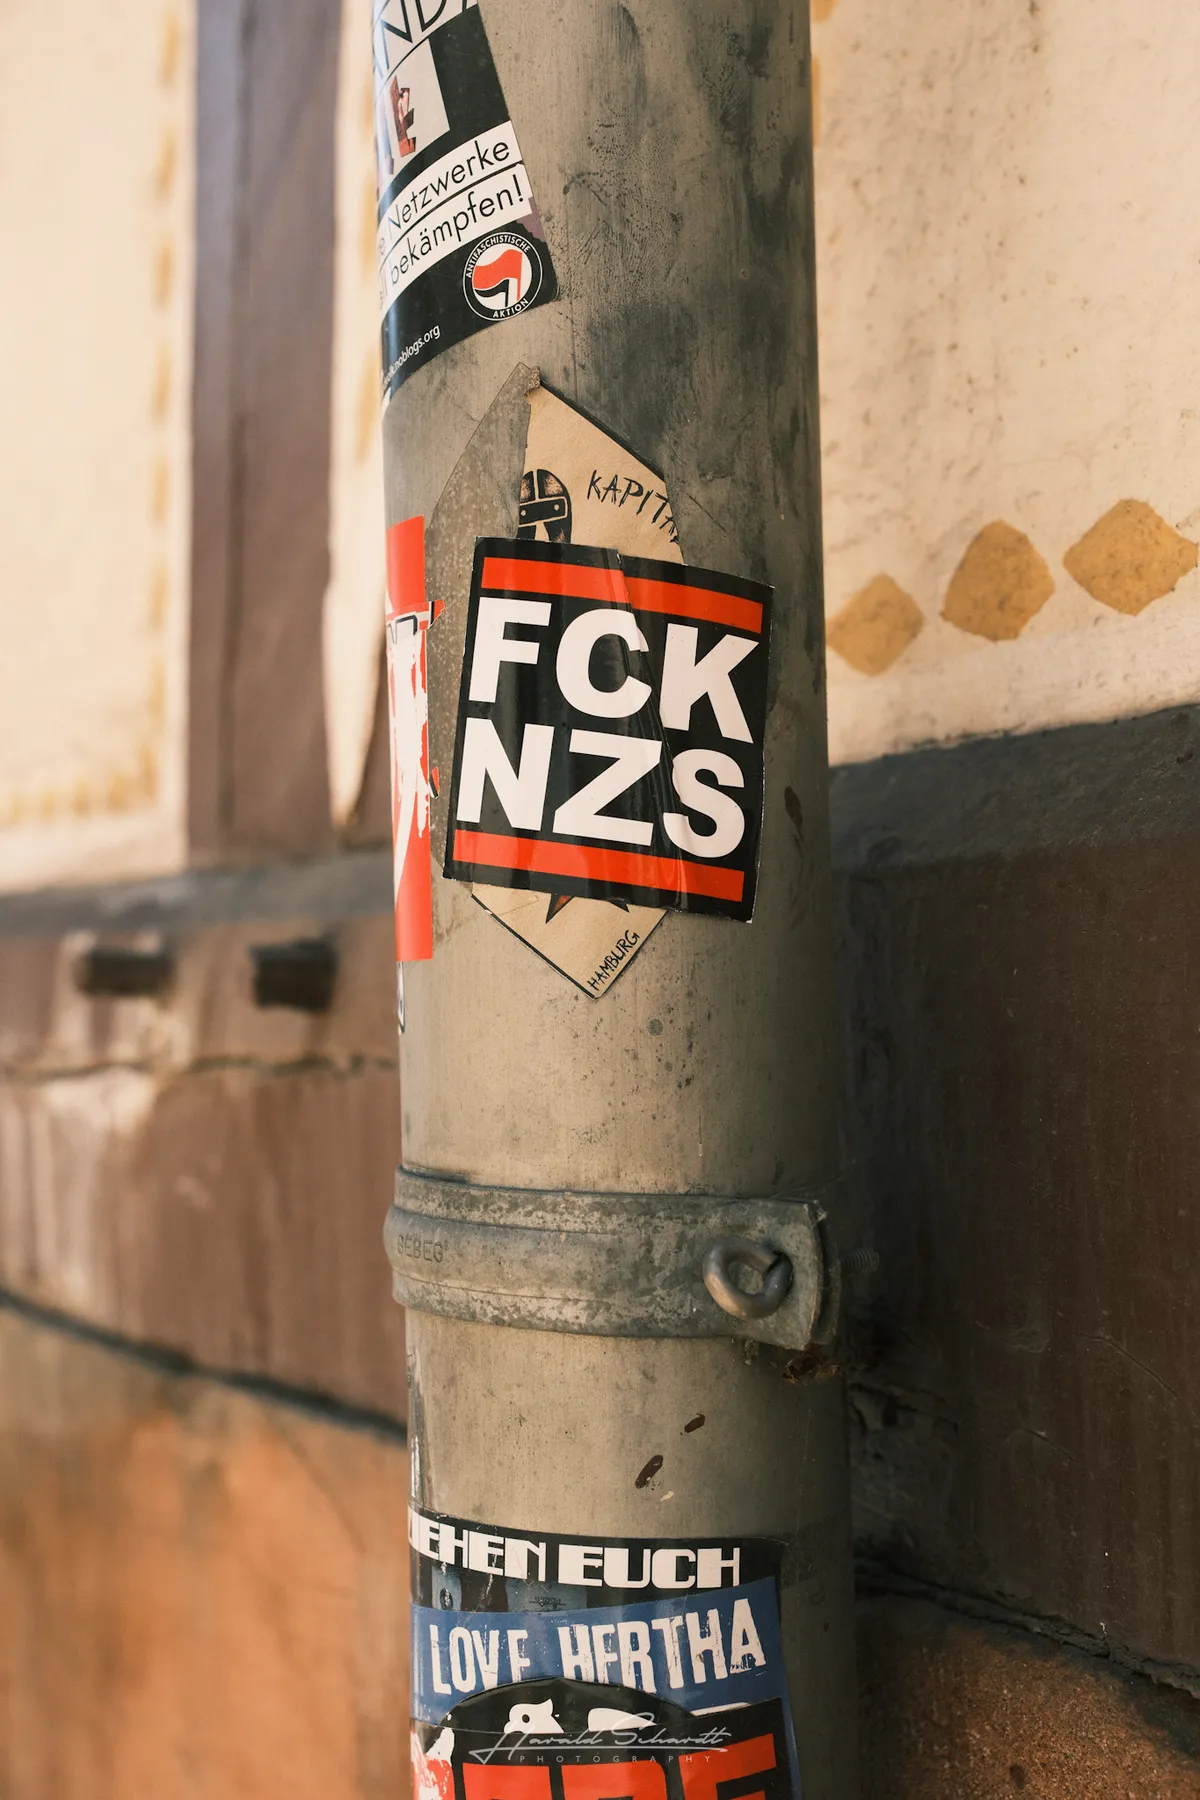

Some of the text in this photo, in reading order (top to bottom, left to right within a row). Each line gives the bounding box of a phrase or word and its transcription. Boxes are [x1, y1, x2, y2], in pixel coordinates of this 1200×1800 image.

[387, 140, 510, 240] Netzwerke
[389, 174, 524, 286] bekämpfen!
[465, 233, 531, 279] ANTIFASCHISTISCHE
[492, 297, 529, 319] AKTION
[468, 596, 760, 744] FCK
[455, 716, 746, 859] NZS
[587, 929, 641, 991] HAMBURG
[557, 1543, 741, 1590] EUCH
[428, 1598, 767, 1695] LOVE HERTHA
